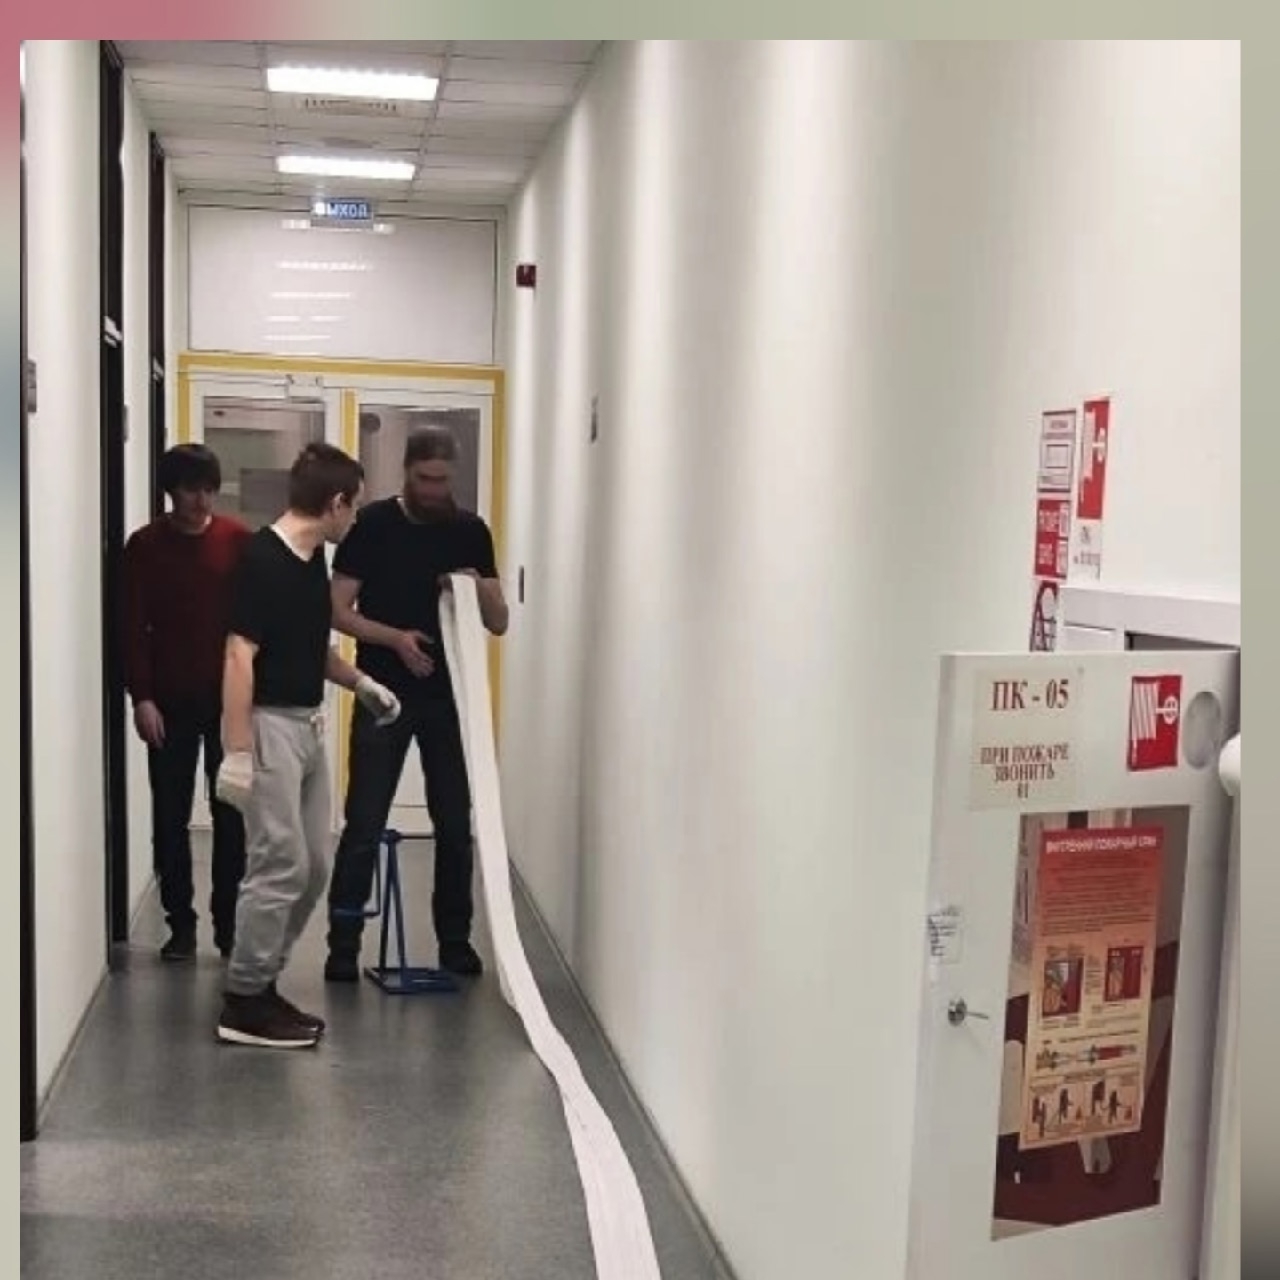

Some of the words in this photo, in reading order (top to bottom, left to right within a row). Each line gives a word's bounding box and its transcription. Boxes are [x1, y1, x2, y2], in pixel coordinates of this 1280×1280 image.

[993, 680, 1028, 710] ПК
[1046, 678, 1069, 709] 05
[981, 747, 1009, 764] ПРИ
[1012, 742, 1069, 763] ПОЖАРЕ
[995, 763, 1055, 782] ЗВОНИТЬ
